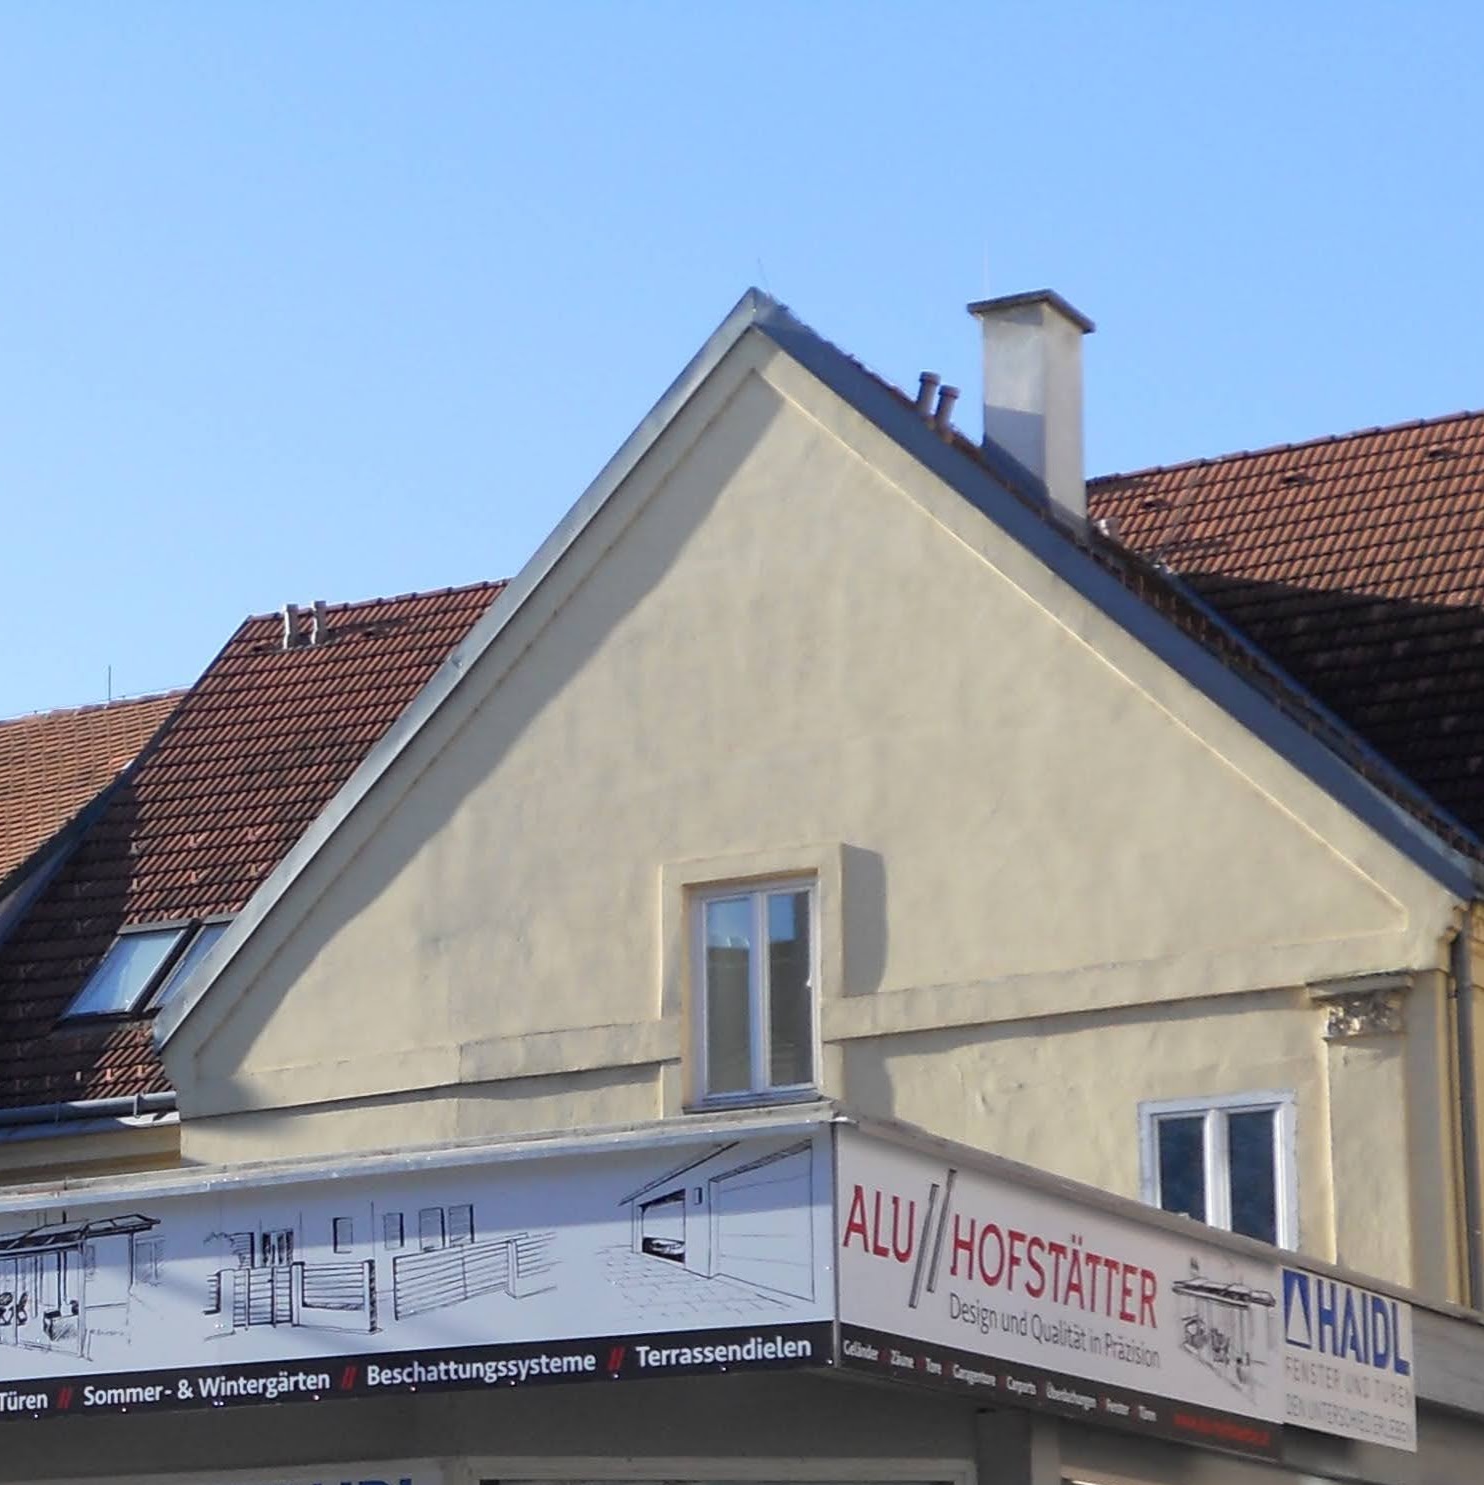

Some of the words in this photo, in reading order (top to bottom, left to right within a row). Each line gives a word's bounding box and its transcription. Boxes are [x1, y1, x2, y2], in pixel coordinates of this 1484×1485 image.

[843, 1184, 915, 1263] ALU
[950, 1212, 1158, 1329] HOFSTÄTTER
[950, 1292, 997, 1335] Design
[1002, 1311, 1027, 1337] und
[1031, 1314, 1086, 1352] Qualität
[1090, 1328, 1100, 1354] in
[1105, 1332, 1160, 1368] Präzision
[1317, 1279, 1410, 1377] HAIDL
[83, 1384, 171, 1408] Sommer-
[178, 1380, 193, 1401] &
[199, 1369, 329, 1402] Wintergärten
[366, 1353, 596, 1391] Beschattungssysteme
[636, 1336, 811, 1367] Terrassendielen
